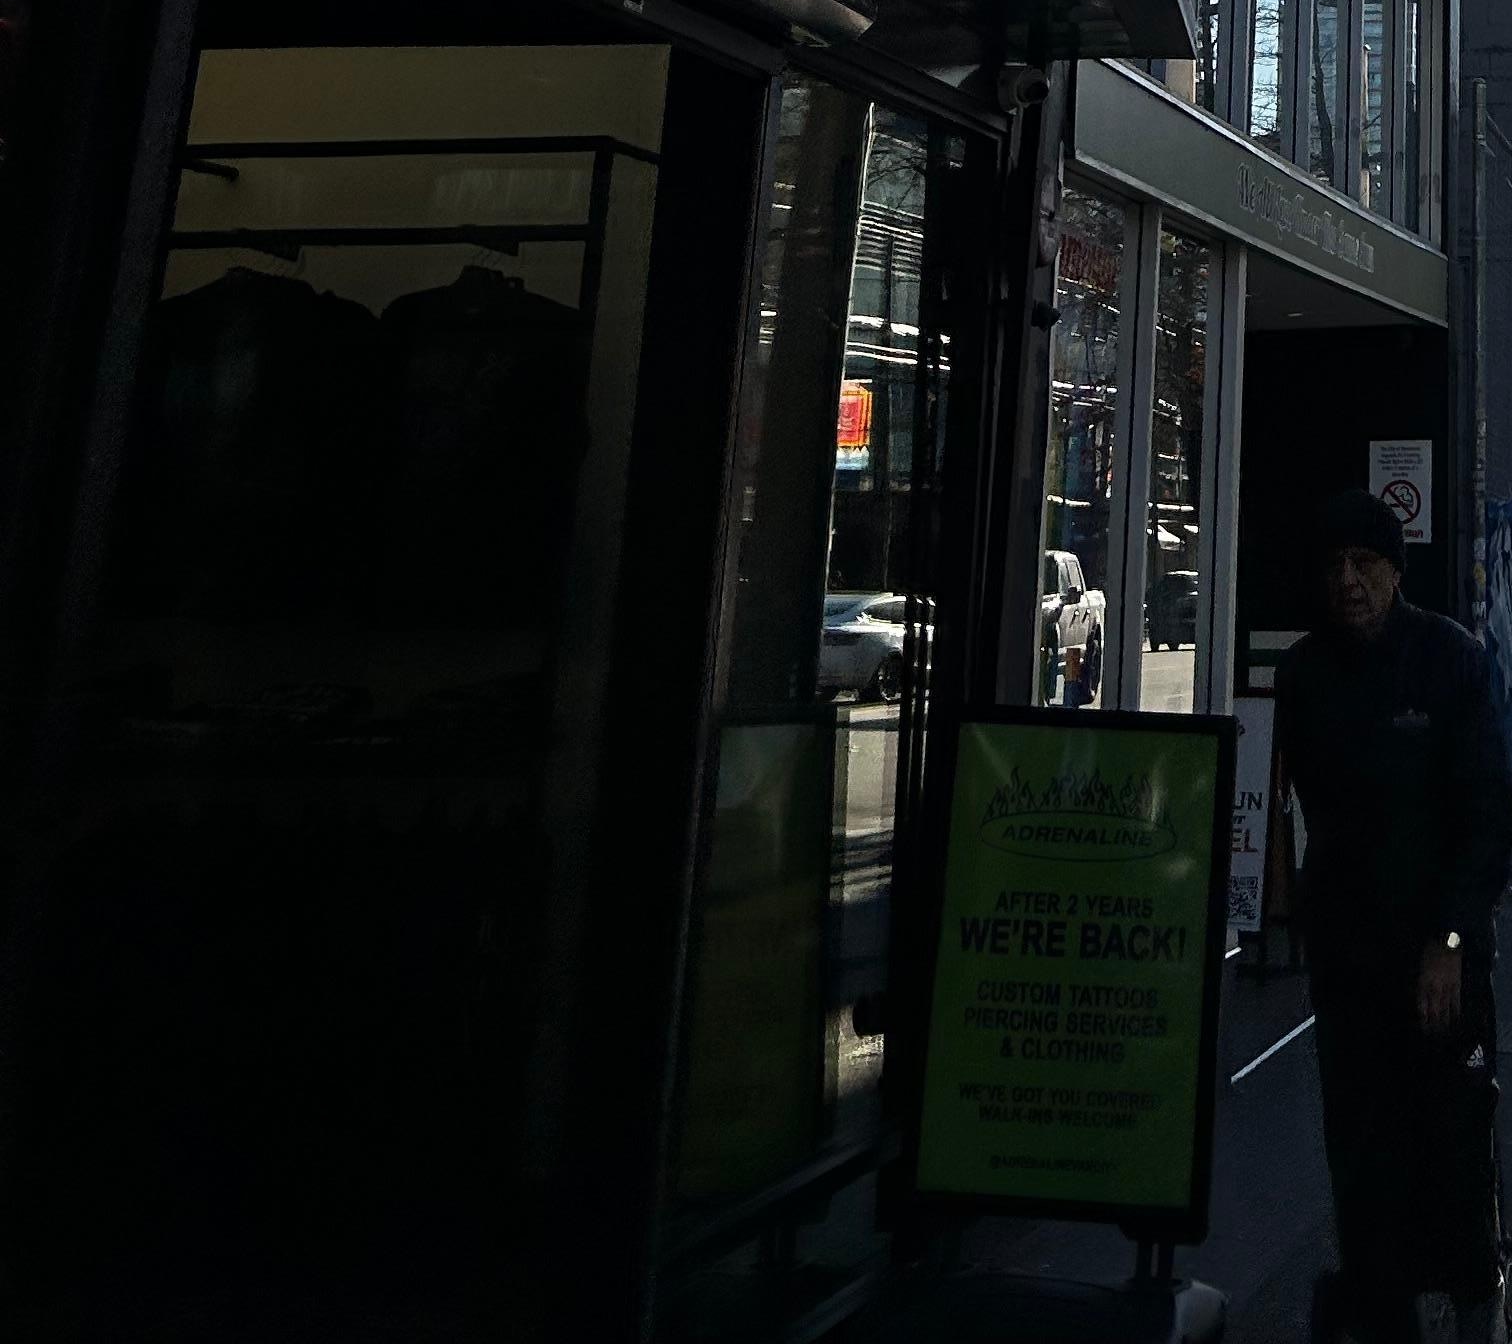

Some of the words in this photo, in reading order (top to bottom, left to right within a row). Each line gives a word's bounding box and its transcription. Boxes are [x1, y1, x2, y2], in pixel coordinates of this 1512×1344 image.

[1002, 823, 1153, 849] ADRENALINE
[996, 891, 1061, 914] AFTER
[1067, 896, 1078, 915] 2
[1087, 895, 1154, 919] YEARS
[960, 917, 1067, 958] WE'RE
[1079, 923, 1186, 962] BACK!
[976, 979, 1061, 1006] CUSTOM
[1070, 985, 1158, 1009] TATTOOS
[964, 1007, 1058, 1034] PIERCING
[1065, 1012, 1168, 1037] SERVICES
[1021, 1039, 1125, 1063] CLOTHING
[1011, 1085, 1045, 1104] GOT
[1050, 1087, 1081, 1106] YOU
